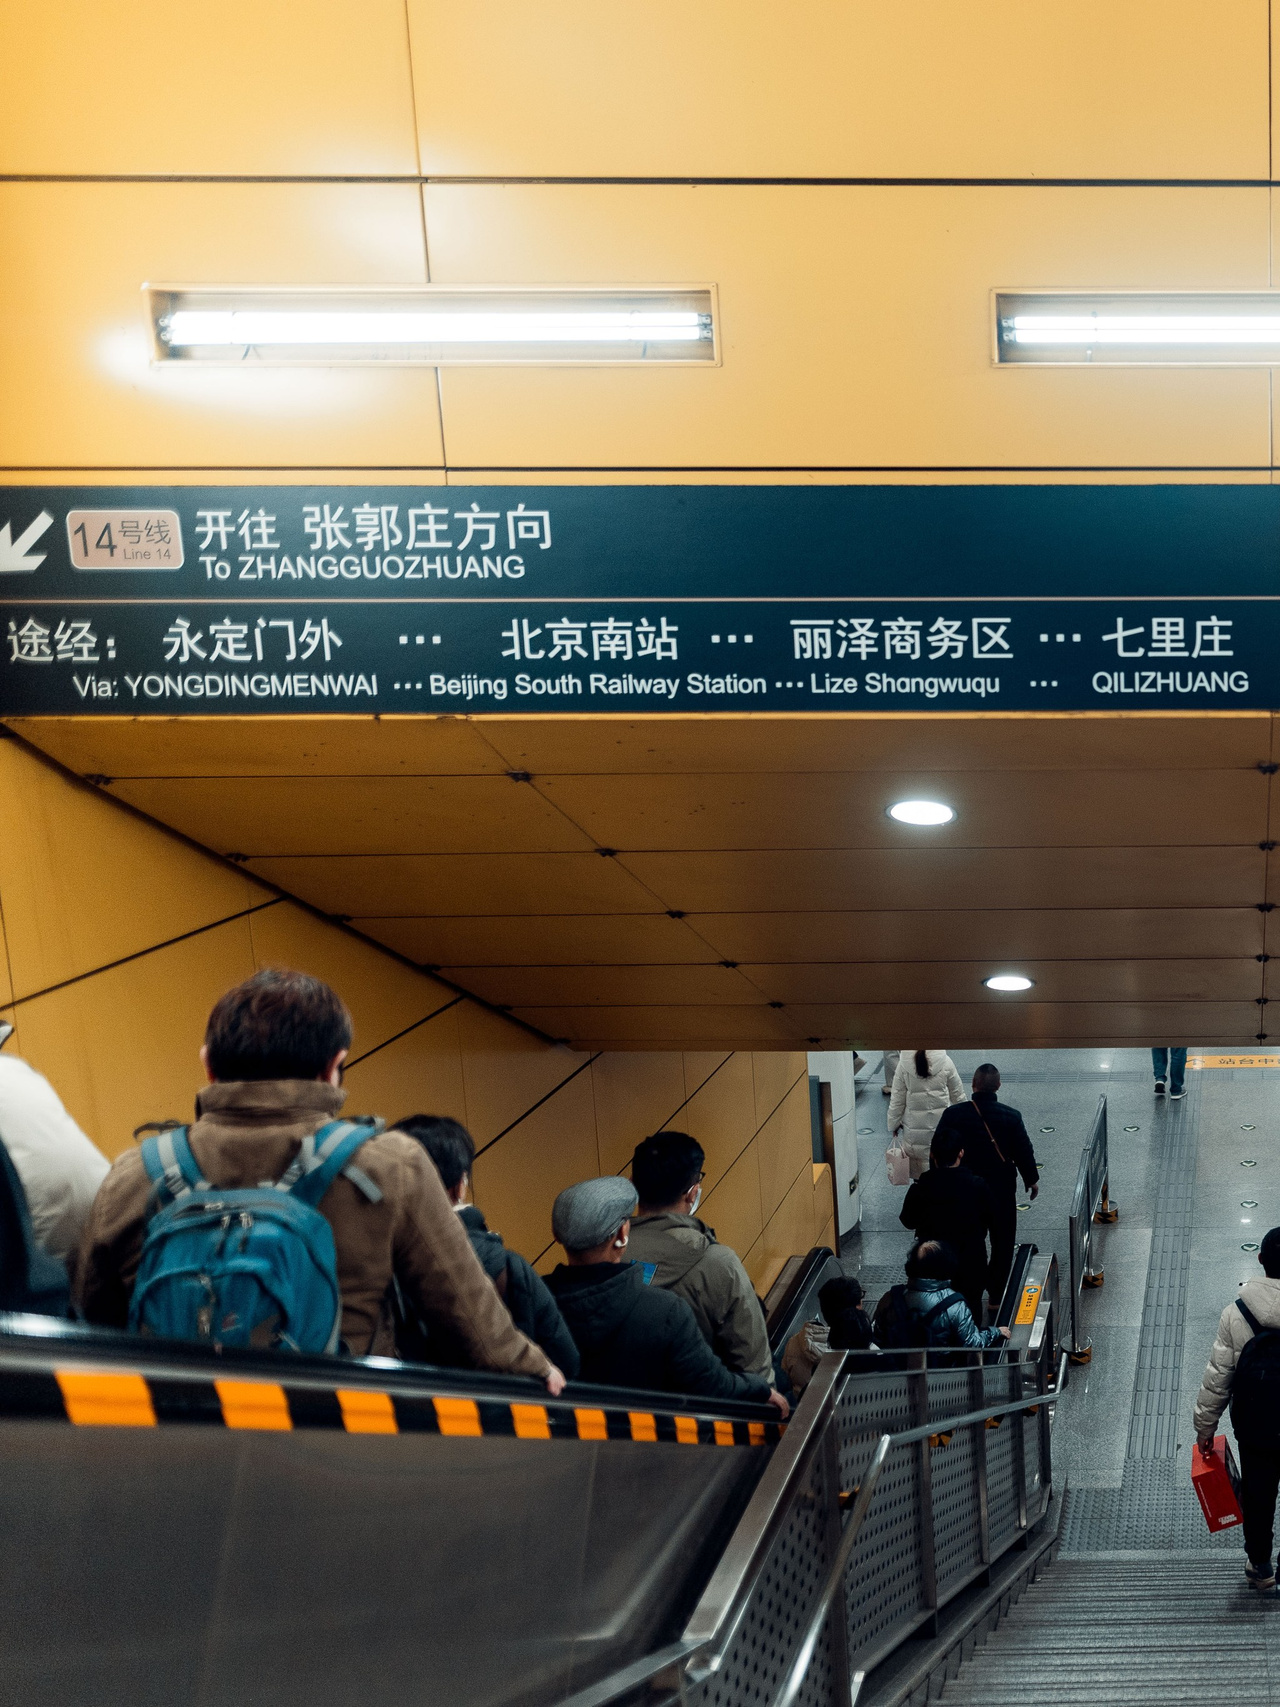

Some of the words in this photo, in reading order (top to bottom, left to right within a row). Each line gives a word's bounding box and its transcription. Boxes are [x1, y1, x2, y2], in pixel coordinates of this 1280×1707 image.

[195, 507, 281, 551] 开往
[302, 501, 552, 552] 张郭庄方向
[122, 548, 152, 560] Line
[156, 548, 172, 560] 14
[198, 555, 231, 580] To
[238, 554, 525, 579] ZHANGGUOZHUANG
[162, 617, 343, 663] 永定门外
[501, 616, 679, 661] 北京南站
[789, 616, 1014, 661] 丽泽商务区
[1101, 615, 1234, 659] 七里庄
[72, 675, 119, 697] Via:
[124, 674, 378, 697] YONGDINGMENWAI
[429, 673, 508, 700] Beijing
[514, 673, 583, 695] South
[589, 673, 680, 699] Railway
[687, 672, 767, 694] Station
[810, 673, 858, 694] Lize
[865, 672, 1000, 699] Shangwuqu
[1092, 670, 1249, 694] QILIZHUANG
